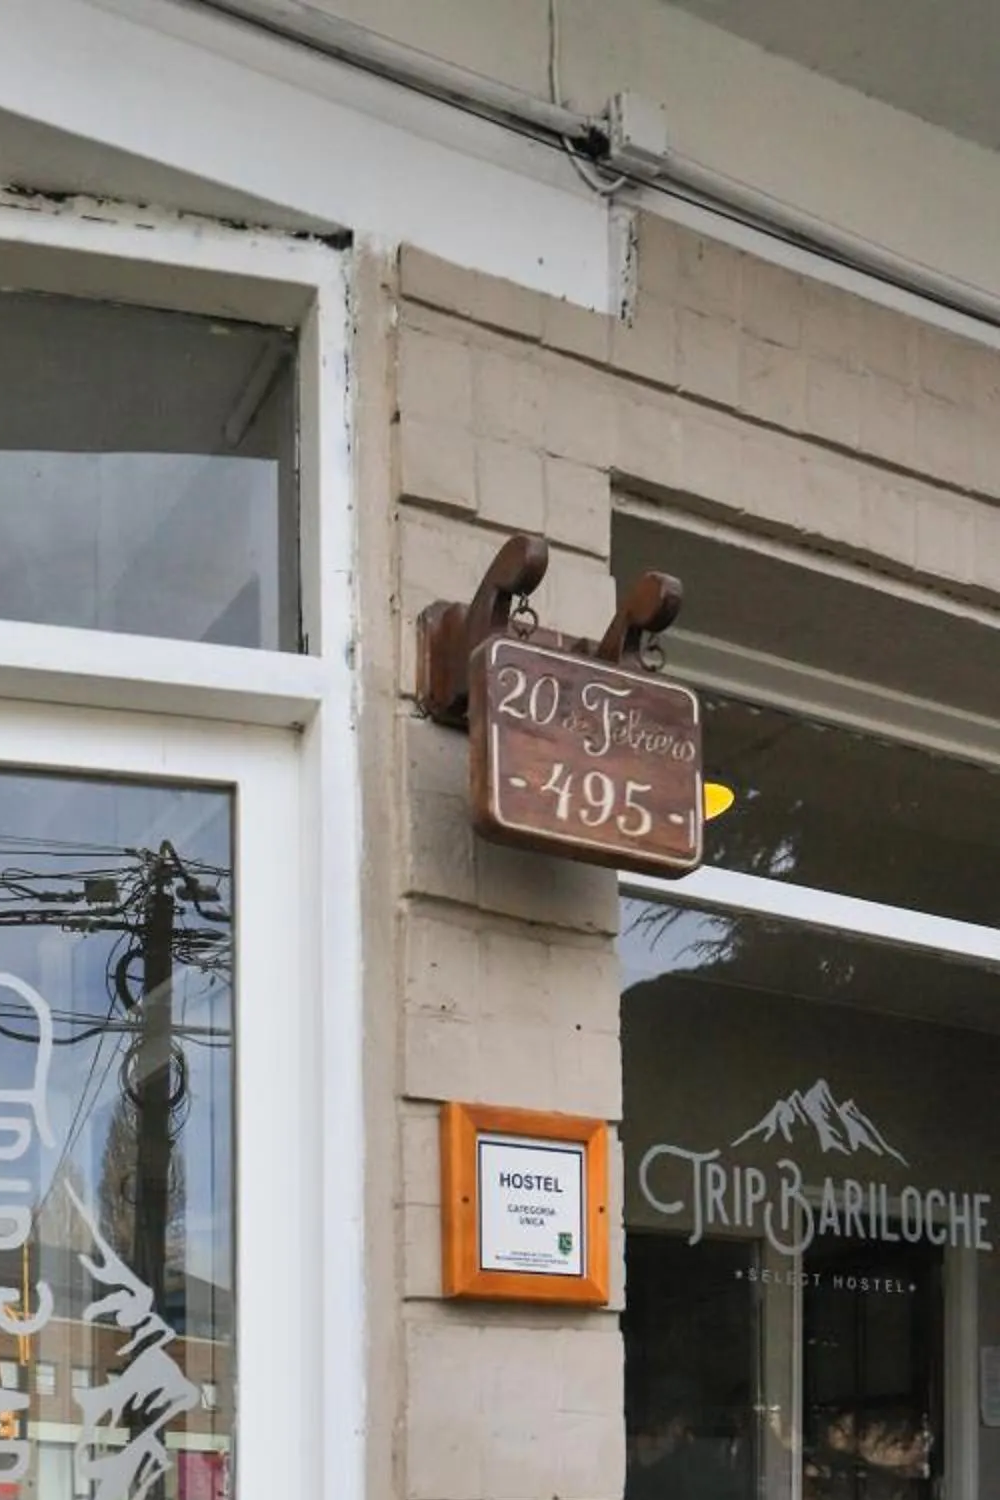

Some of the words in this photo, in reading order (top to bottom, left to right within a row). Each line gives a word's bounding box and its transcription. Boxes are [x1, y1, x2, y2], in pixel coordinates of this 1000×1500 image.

[498, 667, 559, 725] 20
[499, 1172, 563, 1193] HOSTEL
[639, 1143, 766, 1246] TRIP
[764, 1158, 993, 1256] BARILOCHE
[747, 1268, 820, 1287] SELECT
[834, 1276, 904, 1293] HOSTEL
